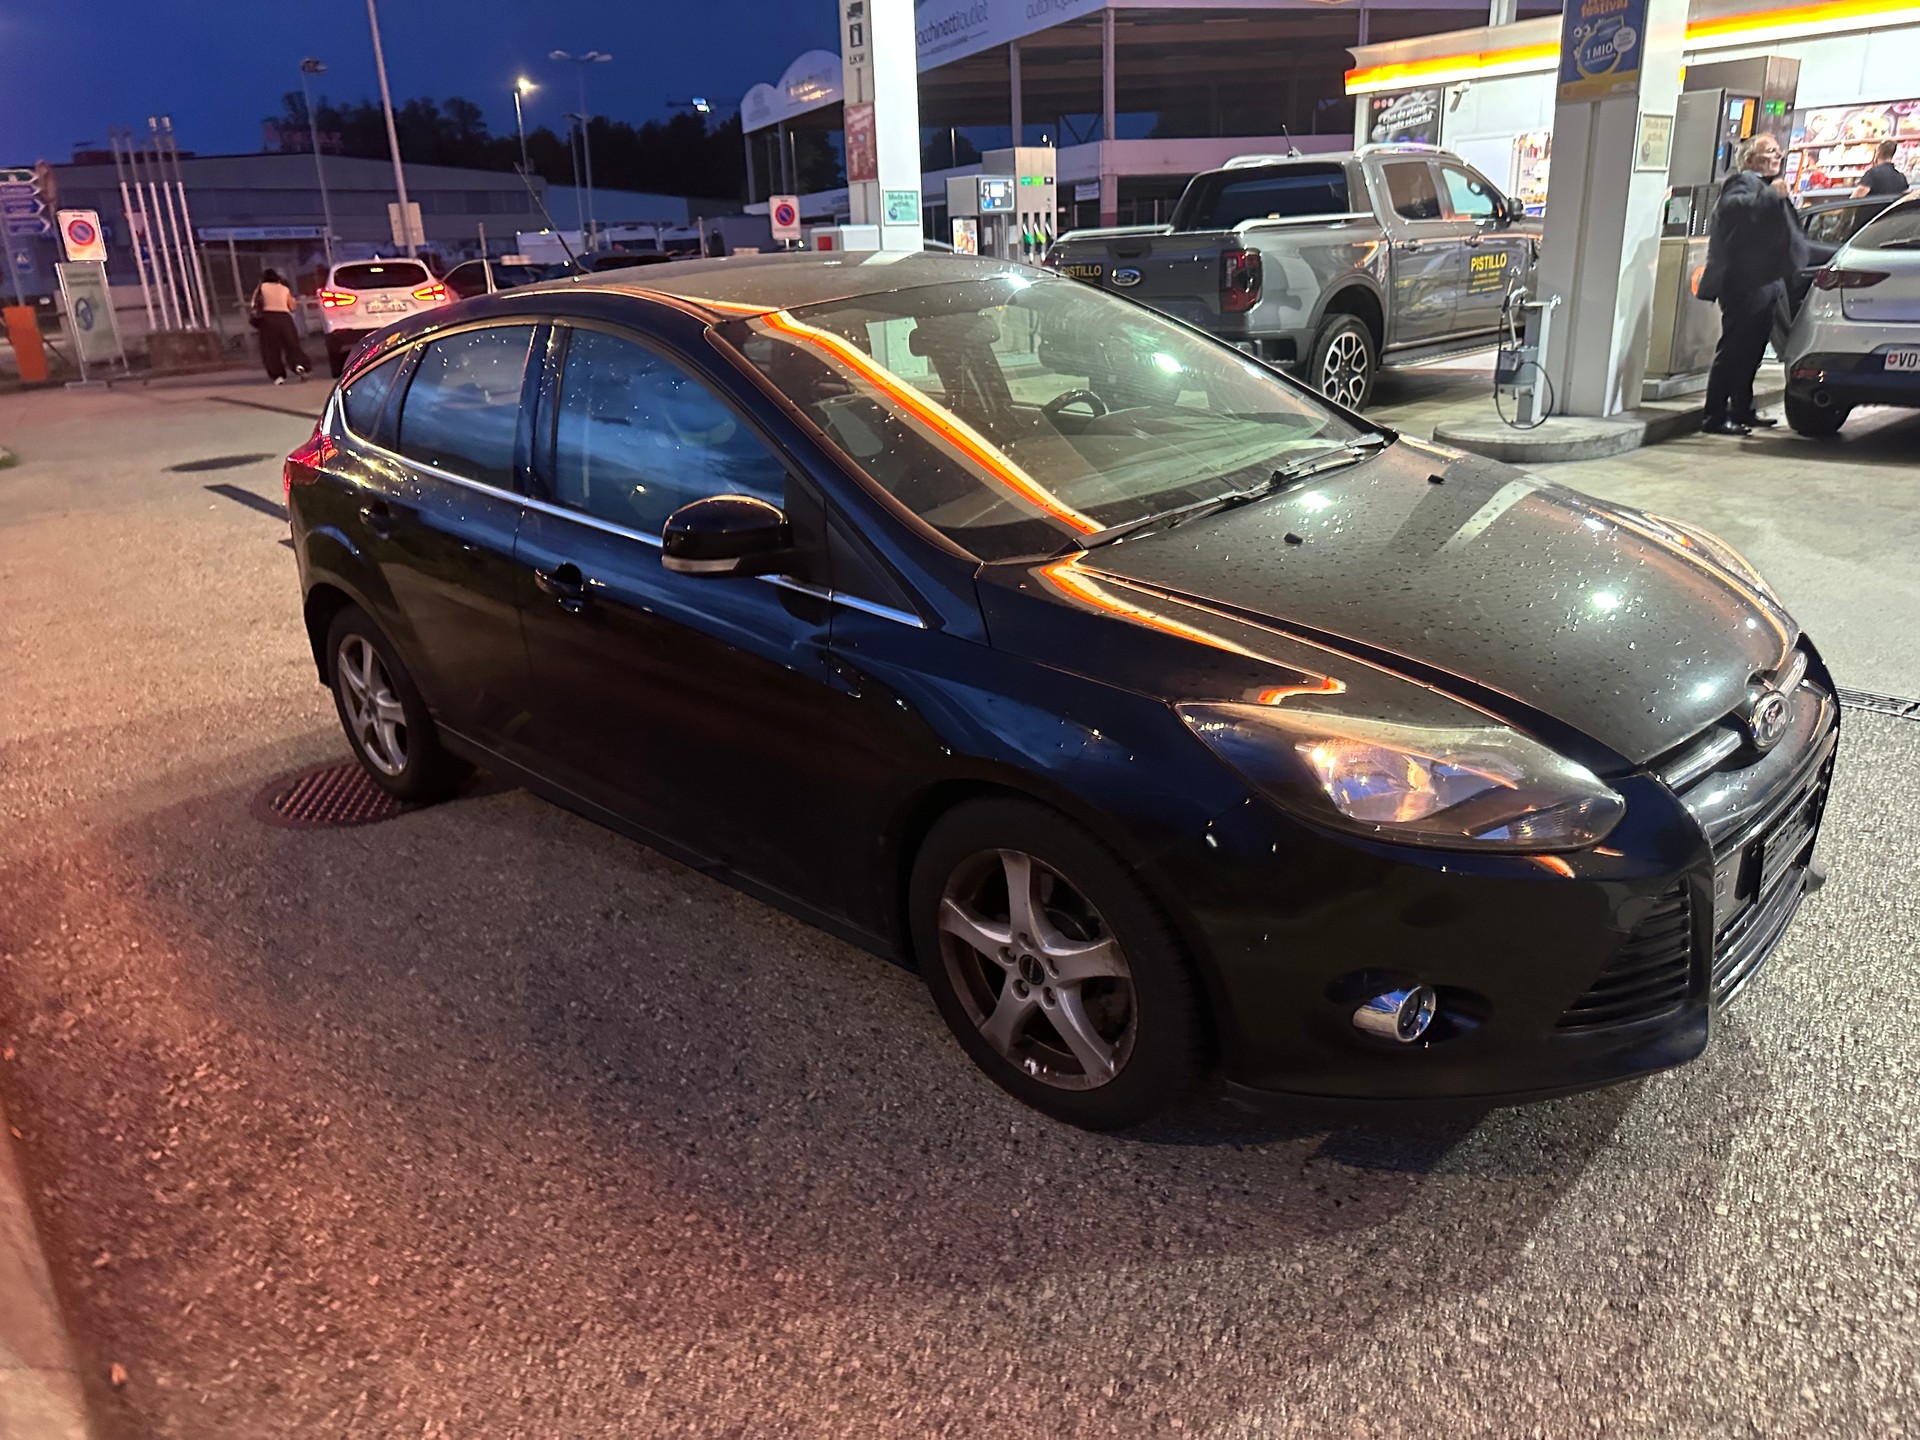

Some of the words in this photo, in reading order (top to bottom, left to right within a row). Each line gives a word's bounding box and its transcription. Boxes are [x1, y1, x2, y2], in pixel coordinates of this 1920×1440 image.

[1585, 49, 1591, 60] 1
[1592, 42, 1613, 58] MIO
[1471, 252, 1507, 272] PISTILLO
[1899, 353, 1918, 367] VD
